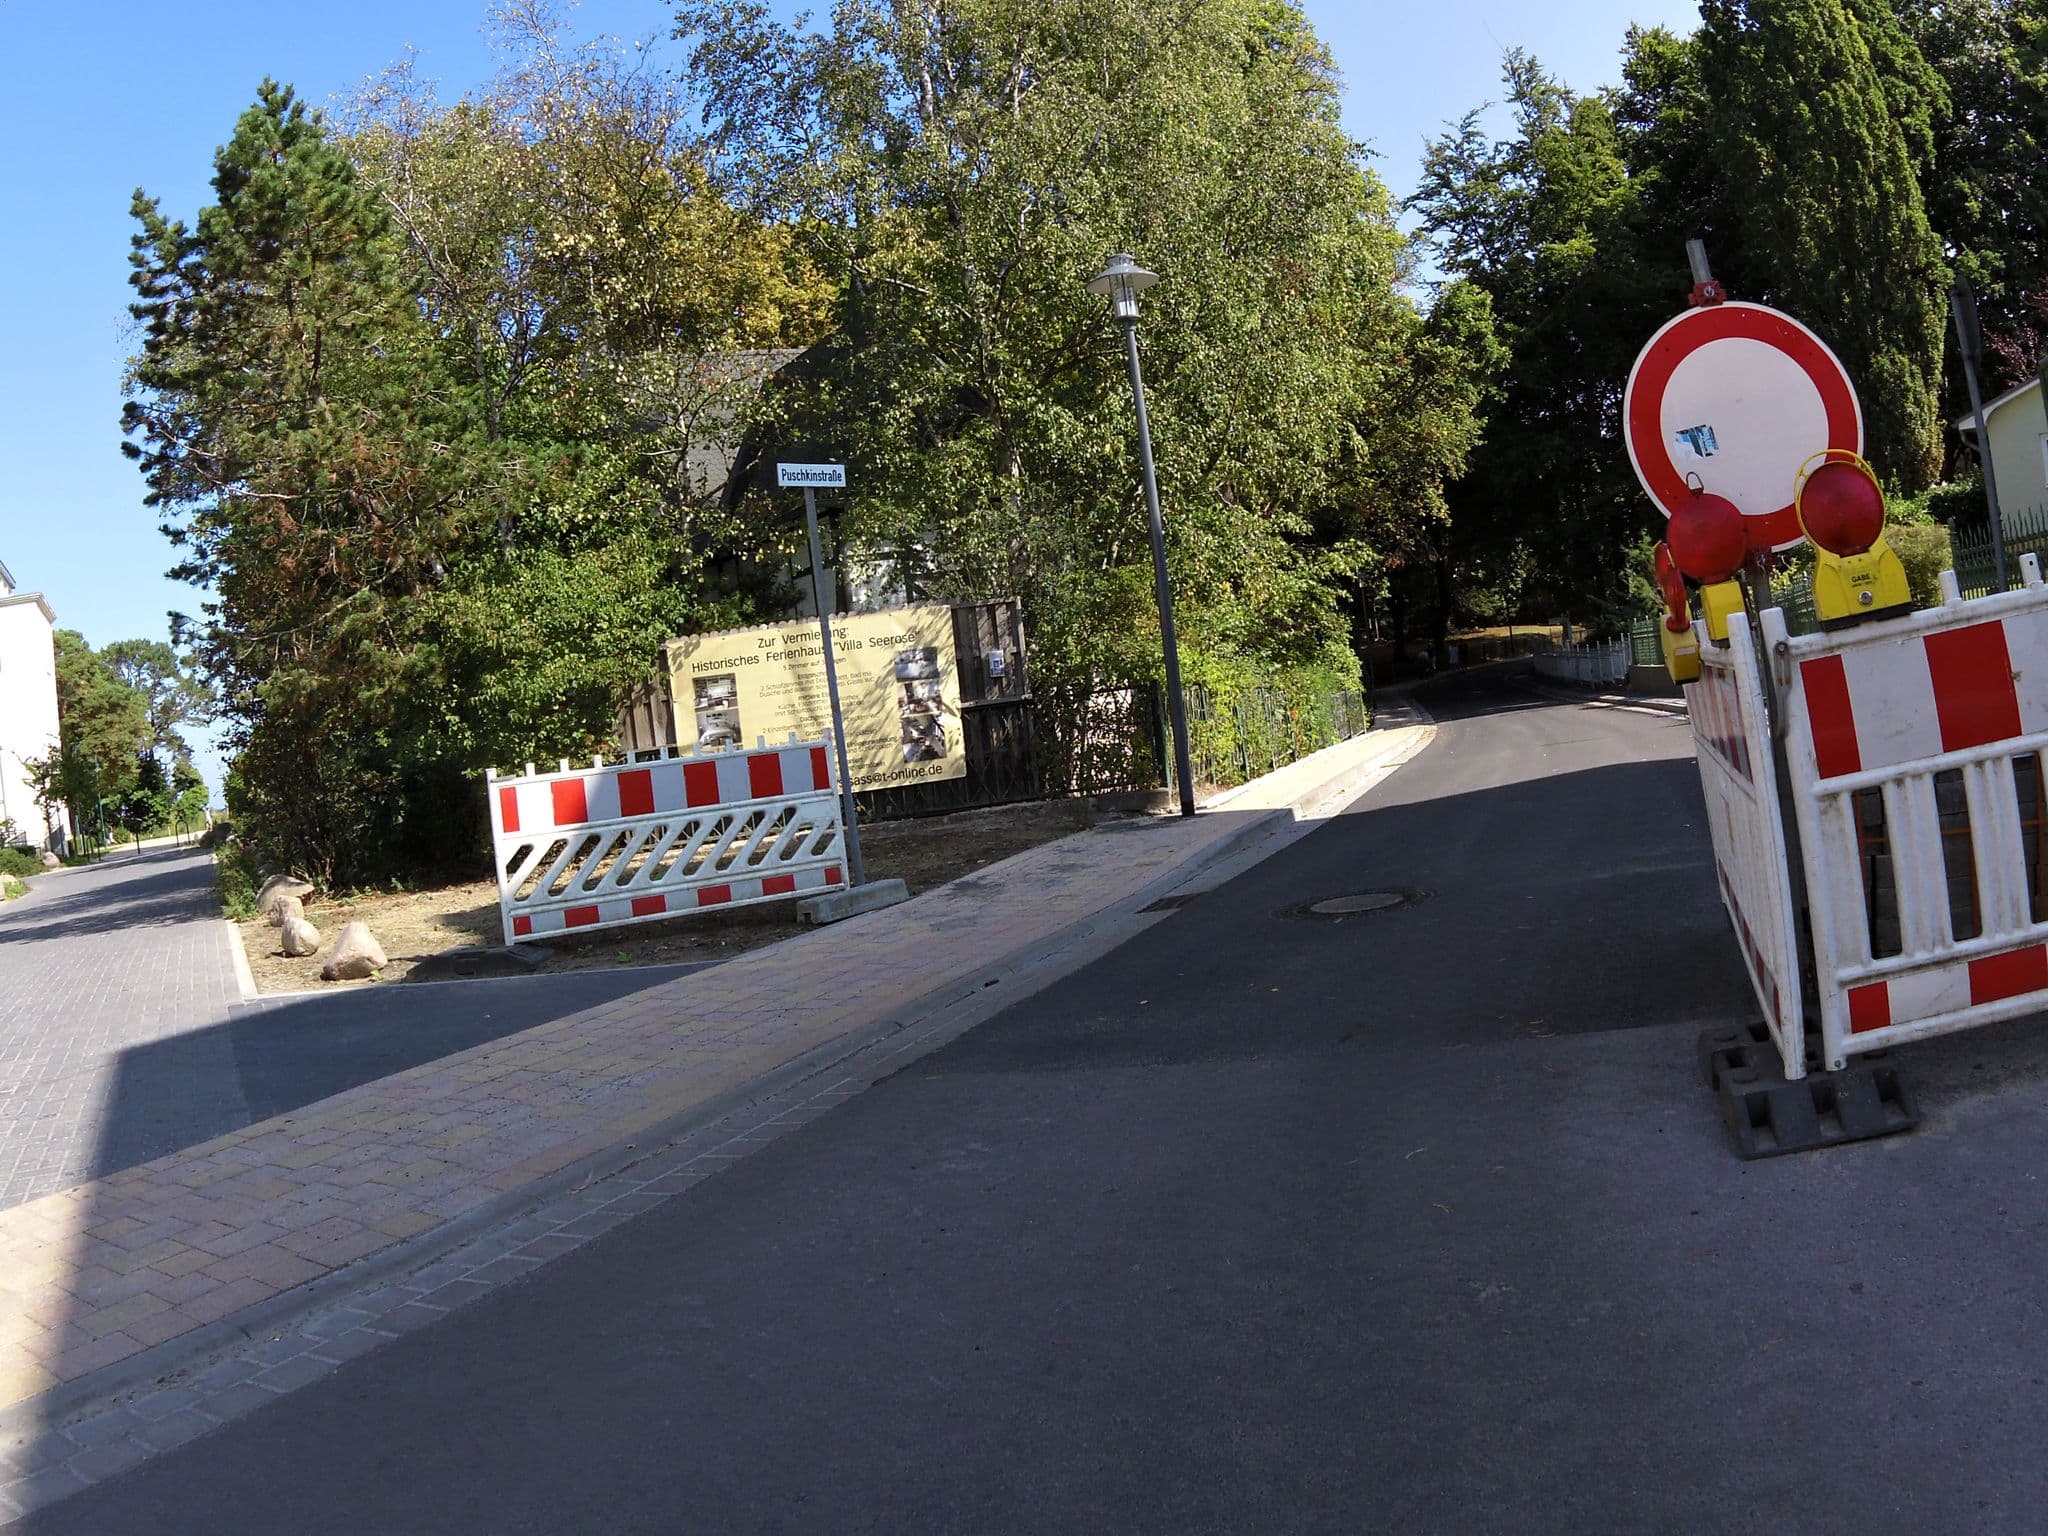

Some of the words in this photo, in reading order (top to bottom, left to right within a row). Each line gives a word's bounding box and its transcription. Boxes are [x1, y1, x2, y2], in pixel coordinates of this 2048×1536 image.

[781, 468, 843, 482] Puschkinstraße
[757, 637, 776, 649] Zur
[781, 628, 849, 645] Vermieng:
[691, 654, 760, 673] Historisches
